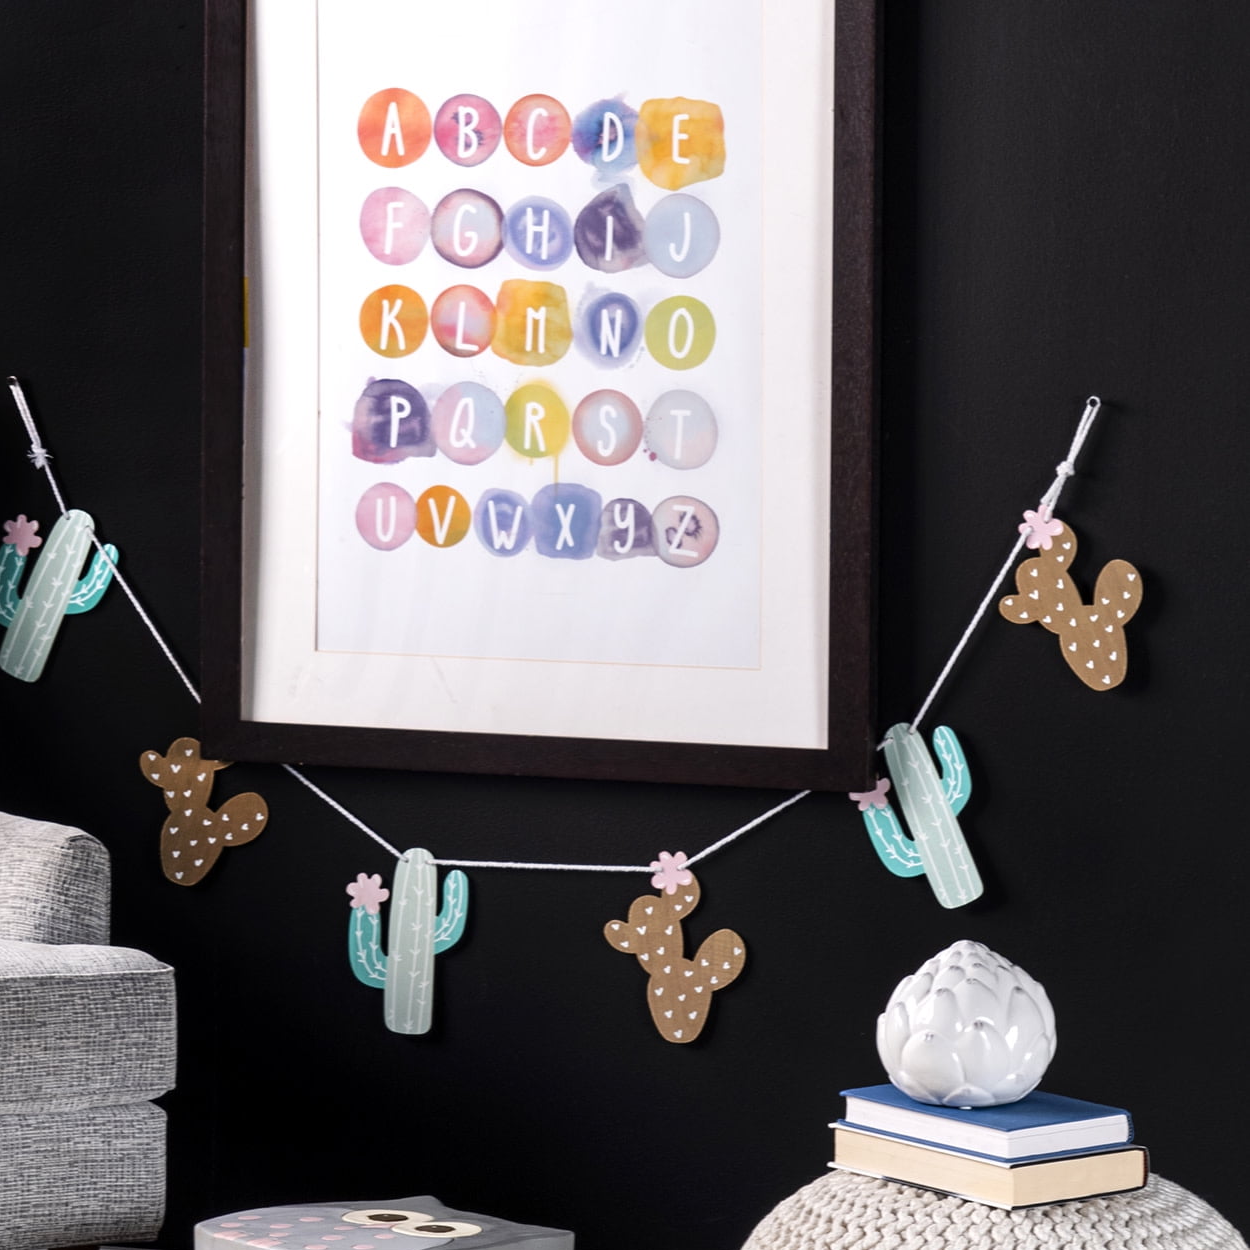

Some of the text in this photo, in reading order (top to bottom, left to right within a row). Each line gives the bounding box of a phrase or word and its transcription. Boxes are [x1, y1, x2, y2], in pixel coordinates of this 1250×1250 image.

[381, 101, 690, 164] A B C D E
[384, 201, 405, 255] F
[453, 204, 478, 257] G
[526, 207, 549, 259] H
[669, 212, 691, 262] J
[379, 299, 694, 359] K L M N O
[390, 396, 690, 459] P Q R S T
[376, 489, 397, 542] U
[427, 495, 457, 547] V
[488, 499, 522, 551] W
[555, 503, 575, 551] X
[669, 505, 698, 558] Z
